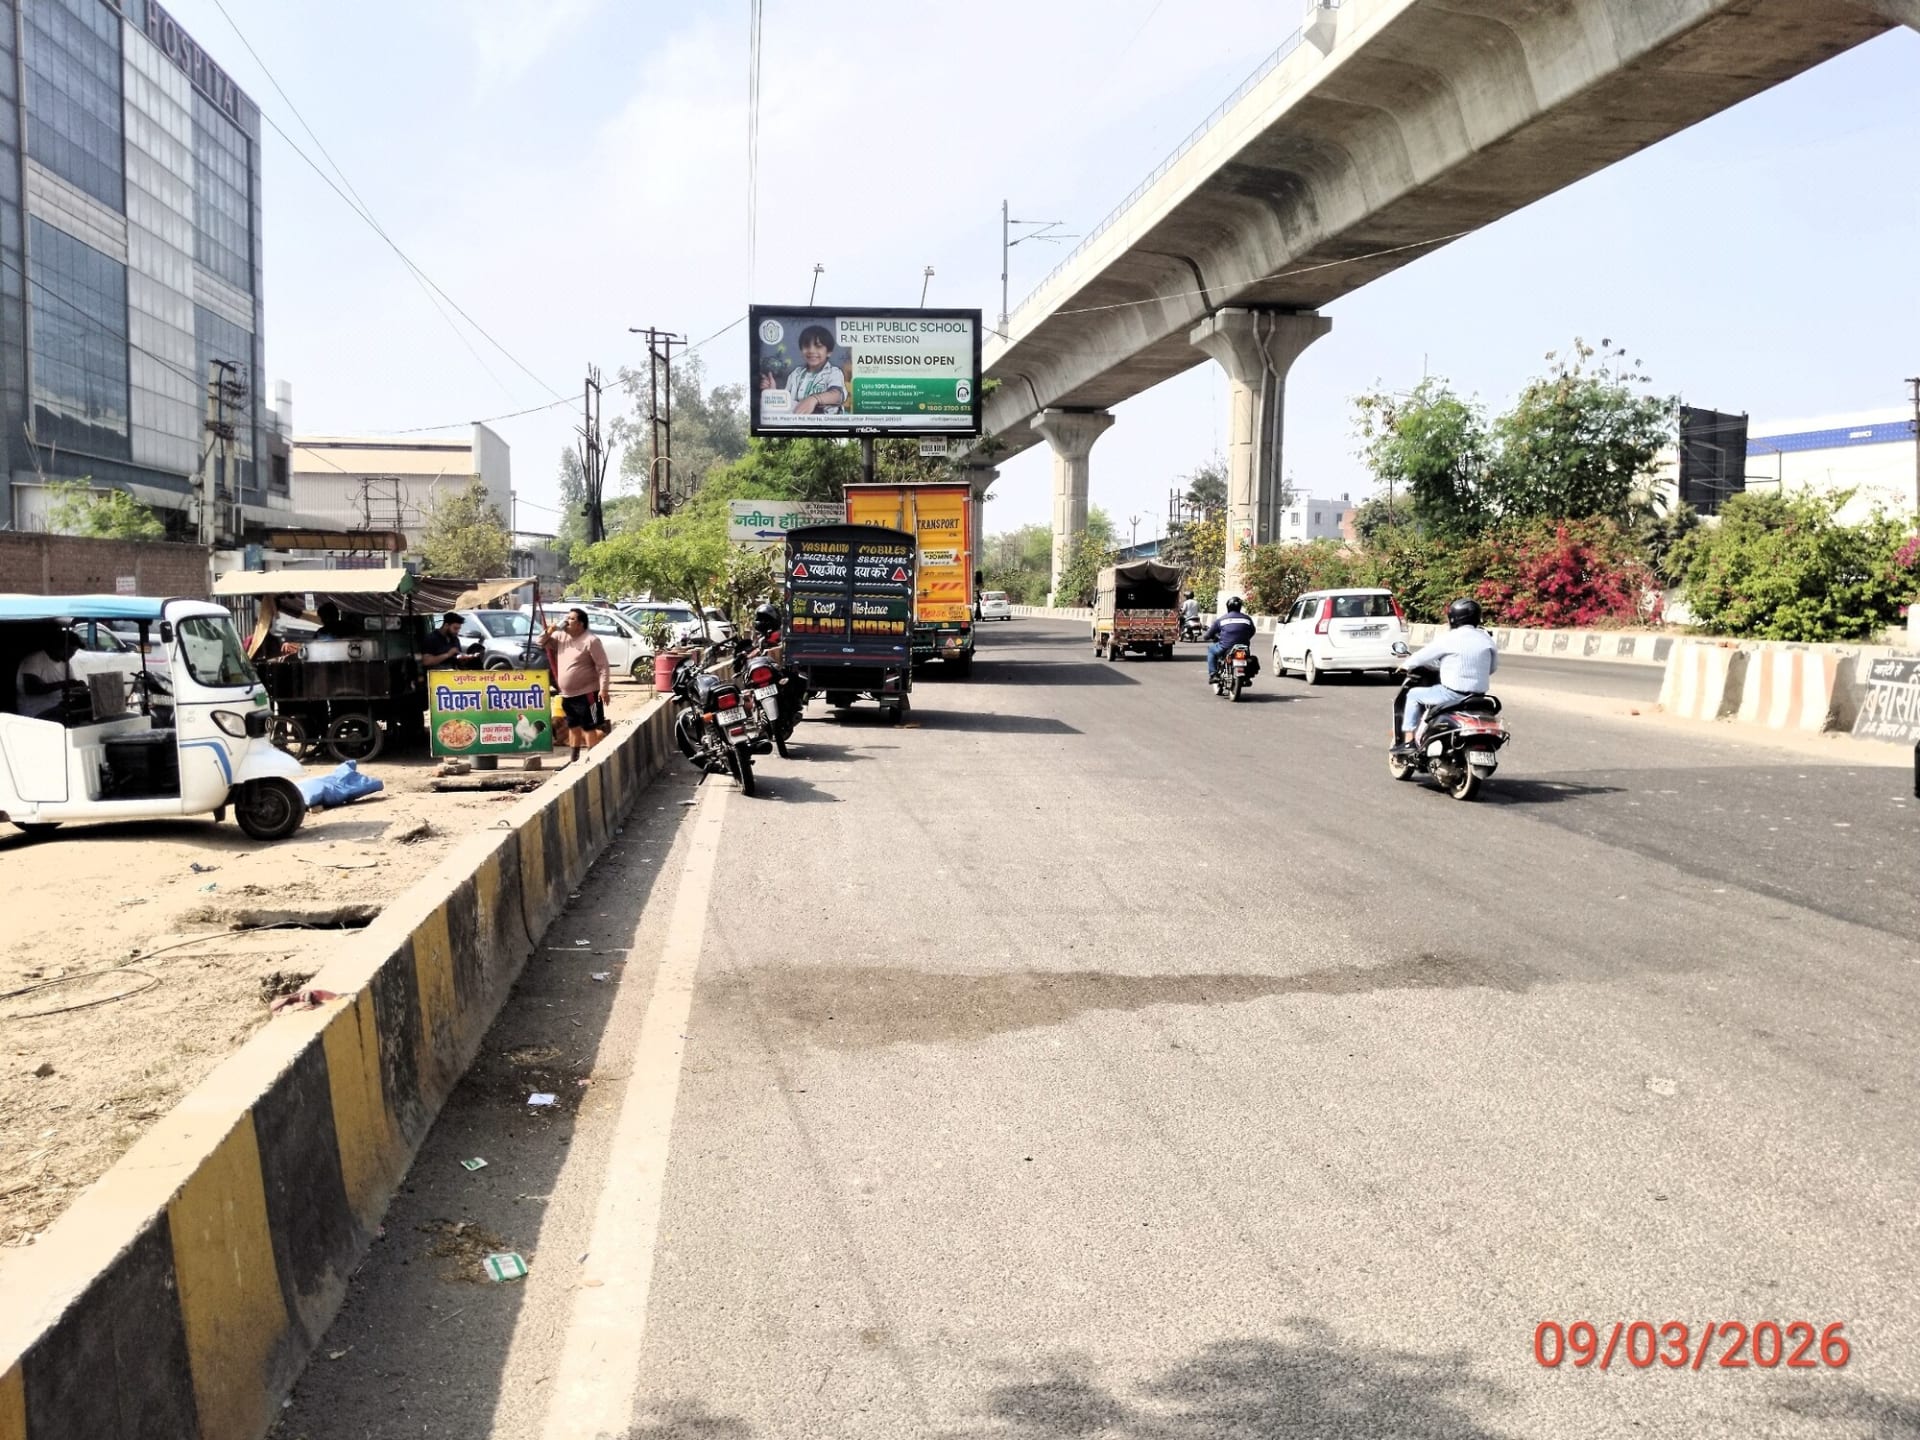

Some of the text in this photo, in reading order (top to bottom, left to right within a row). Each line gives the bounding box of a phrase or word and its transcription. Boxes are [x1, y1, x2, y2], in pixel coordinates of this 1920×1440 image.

[840, 321, 968, 333] DELHI PUBLIC SCHOOL
[840, 334, 920, 344] R.N. EXTENSION
[857, 355, 955, 366] ADMISSION OPEN
[735, 511, 774, 527] नवीन
[917, 518, 960, 529] TRANSPORT
[859, 545, 907, 555] MOBILES
[813, 600, 836, 616] Keep
[793, 617, 905, 635] BLOW HORN
[479, 673, 496, 682] भाई
[499, 673, 510, 682] की
[436, 684, 544, 710] चिकन बिरयानी
[1866, 674, 1920, 723] बवासी
